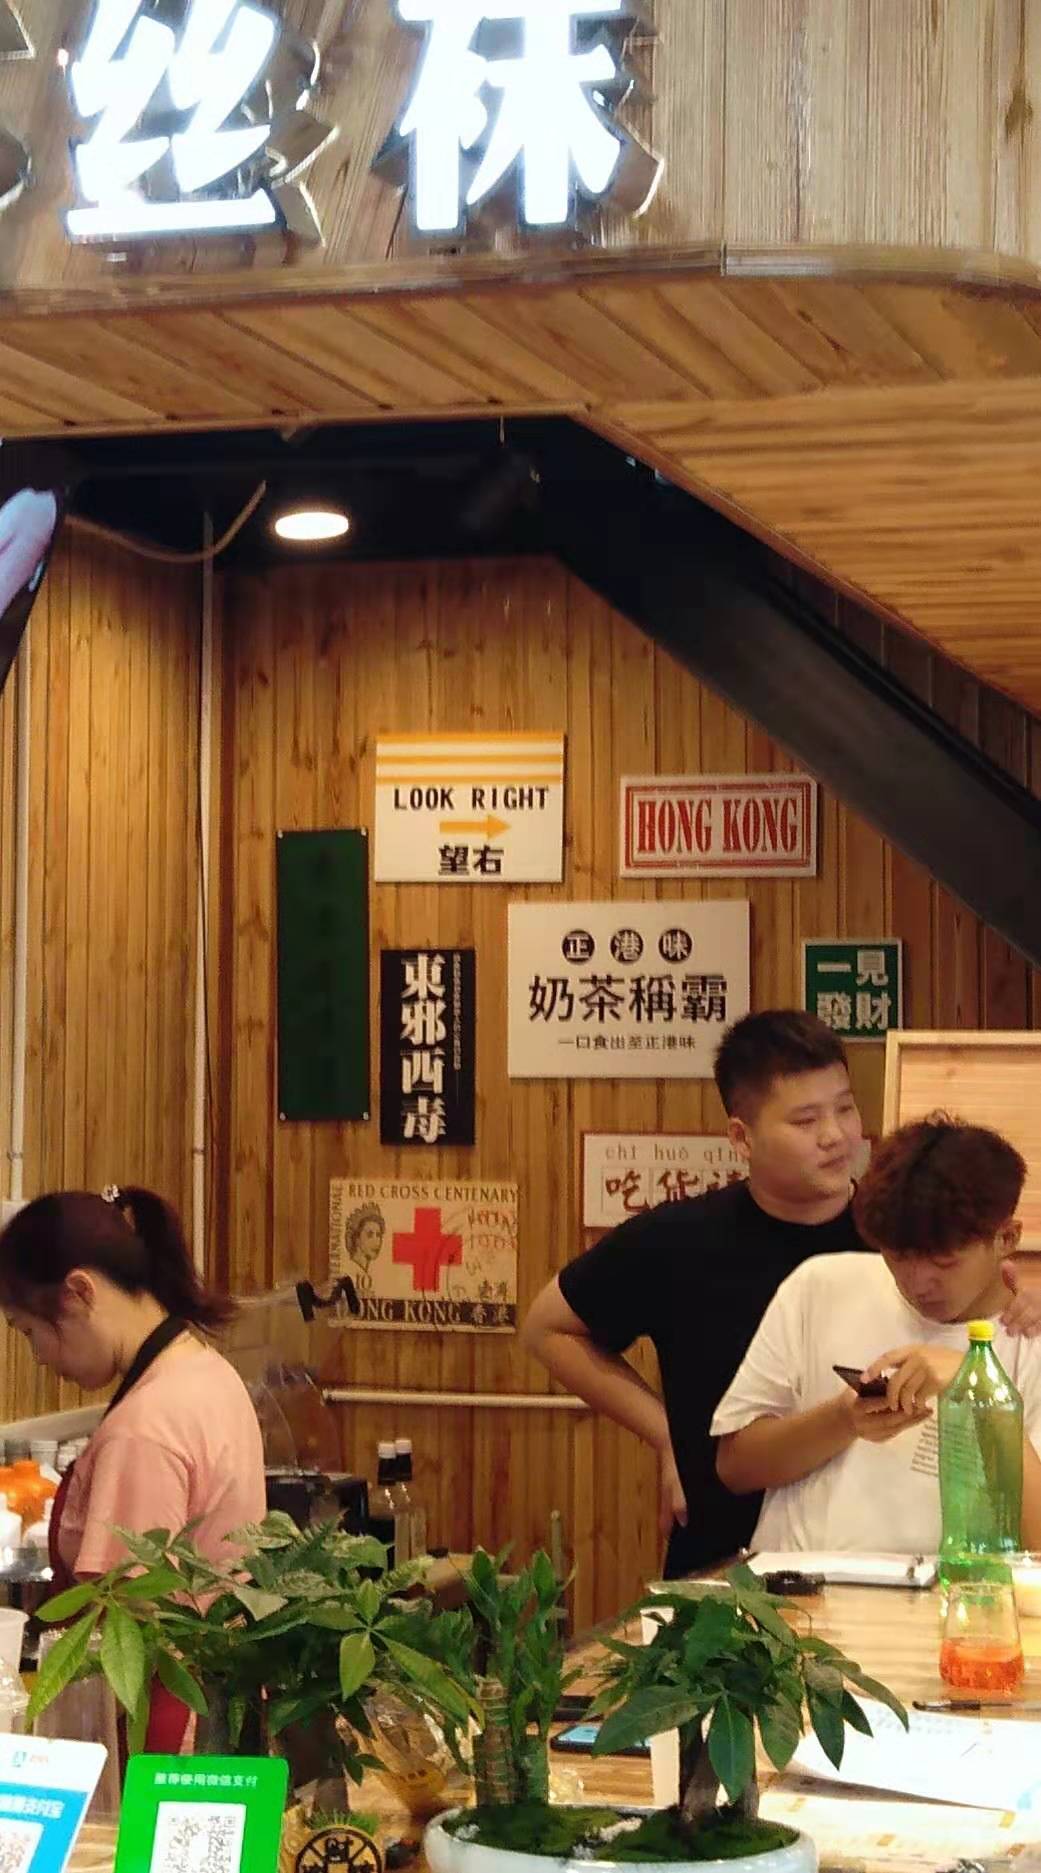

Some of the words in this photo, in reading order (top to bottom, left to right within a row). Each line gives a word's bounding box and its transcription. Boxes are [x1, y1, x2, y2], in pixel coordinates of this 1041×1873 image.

[66, 0, 622, 232] 丝袜
[393, 787, 454, 810] LOOK
[471, 787, 550, 810] RIGHT
[637, 797, 712, 854] HONG
[722, 797, 799, 854] KONG
[438, 844, 504, 875] 望右
[562, 928, 692, 964] 正港味
[816, 949, 889, 987] 一見
[528, 974, 728, 1024] 奶茶稱霸
[816, 991, 892, 1031] 發財
[400, 952, 447, 1144] 東邪西毒
[349, 1184, 375, 1199] RED
[379, 1185, 429, 1201] CROSS
[433, 1186, 519, 1204] CENTENARY
[403, 1301, 461, 1323] KONG
